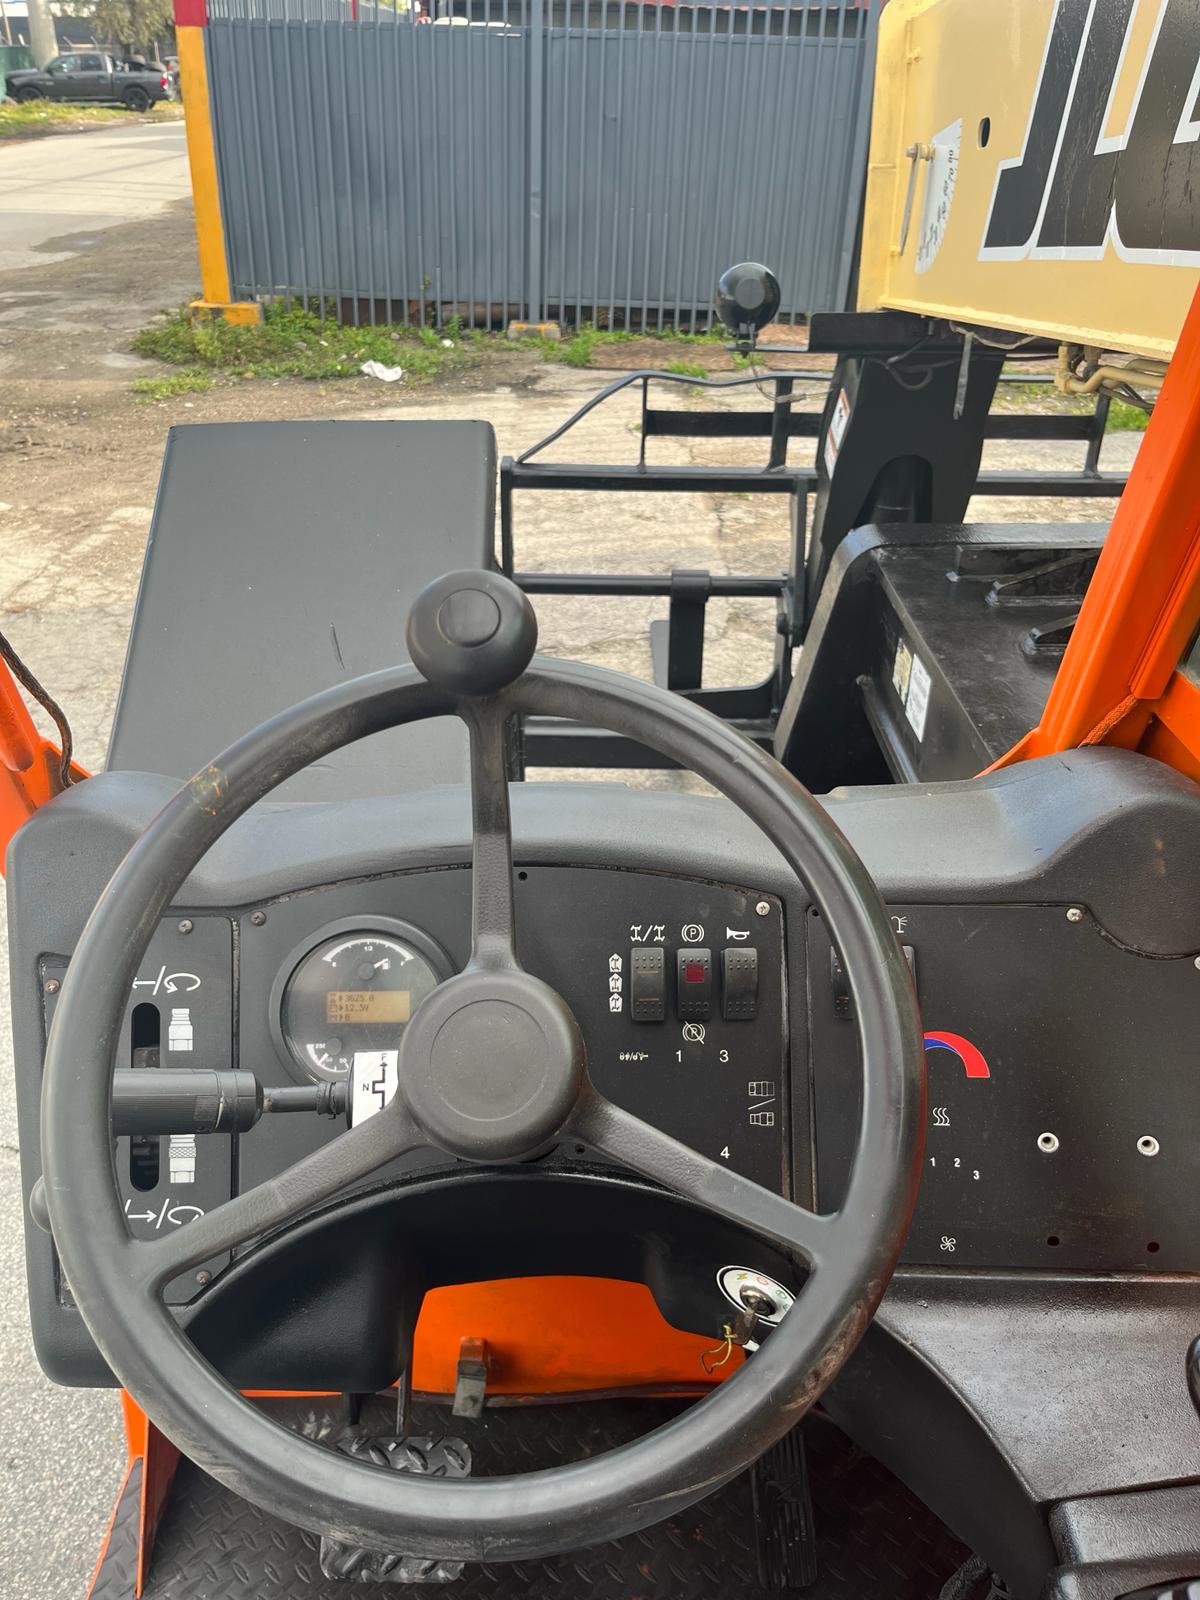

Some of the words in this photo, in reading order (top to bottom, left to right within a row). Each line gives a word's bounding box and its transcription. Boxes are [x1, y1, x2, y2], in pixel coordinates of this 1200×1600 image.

[381, 1052, 388, 1061] F
[675, 1049, 682, 1063] 1
[719, 1049, 729, 1063] 3
[362, 1082, 370, 1092] N
[720, 1145, 731, 1159] 4
[929, 1156, 936, 1168] 1
[953, 1157, 961, 1168] 2
[972, 1169, 980, 1180] 3
